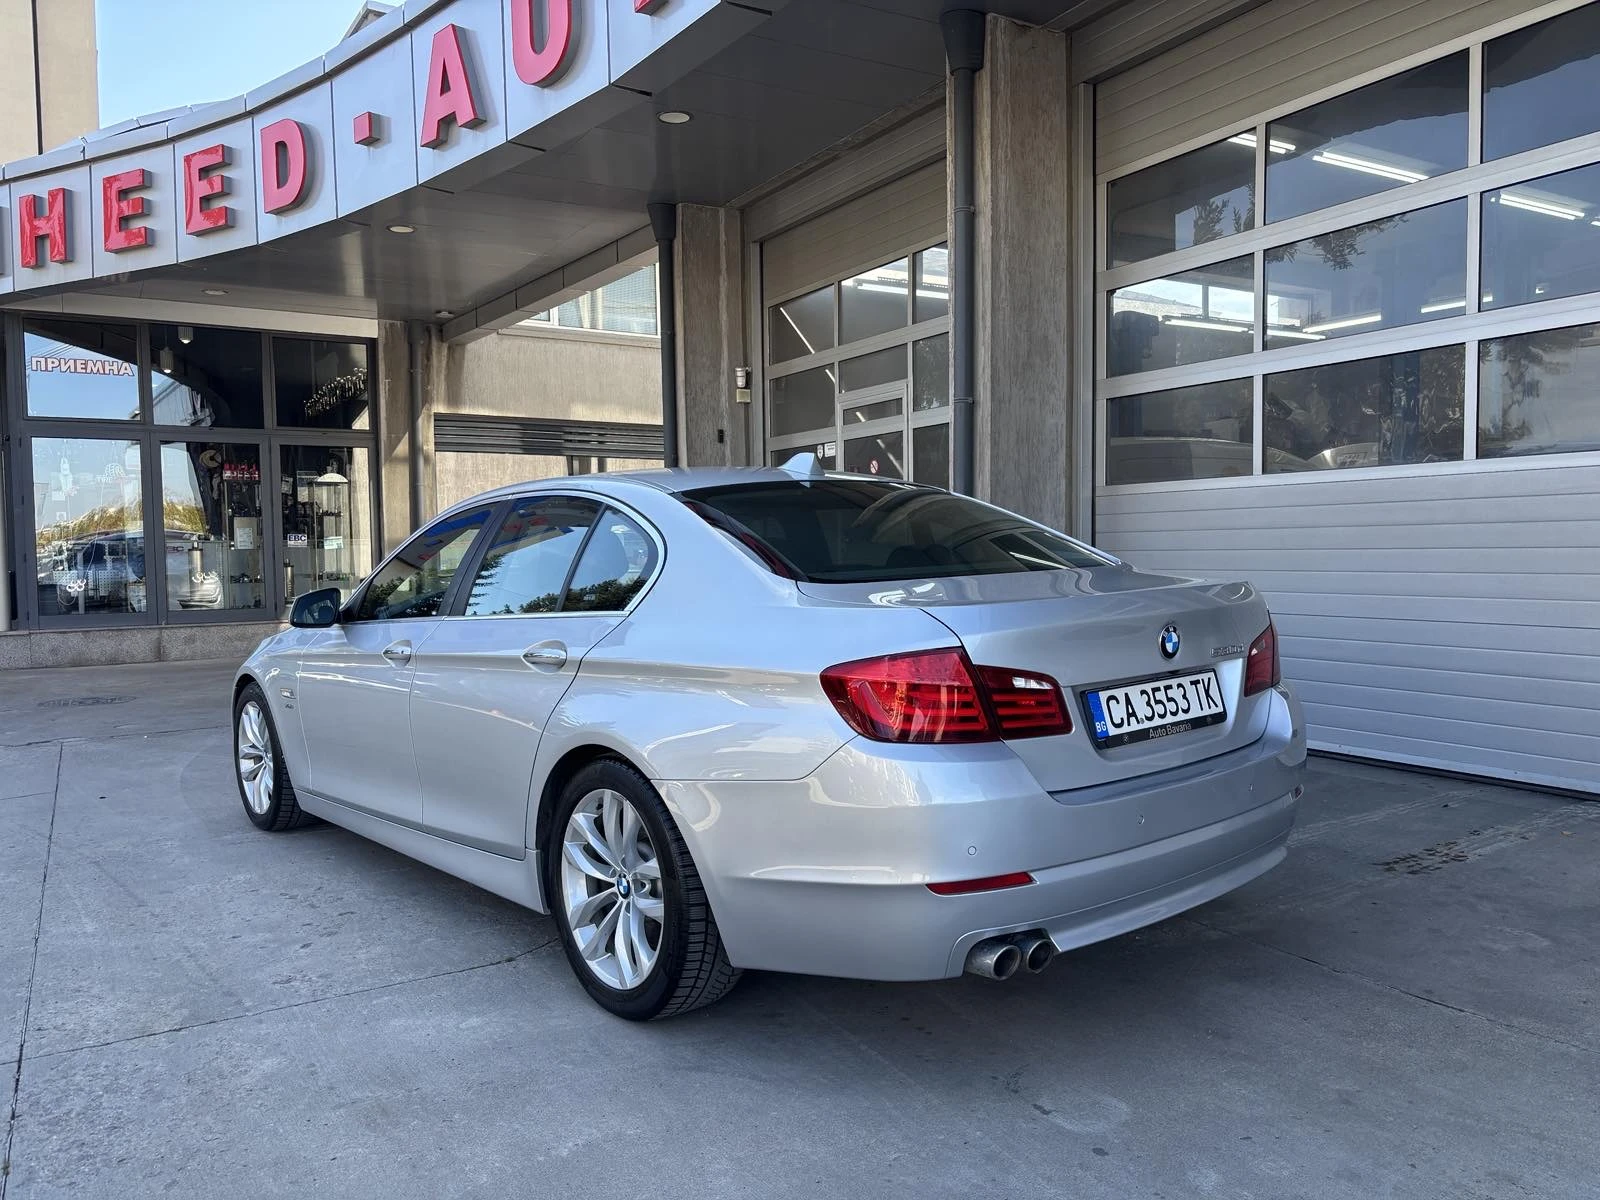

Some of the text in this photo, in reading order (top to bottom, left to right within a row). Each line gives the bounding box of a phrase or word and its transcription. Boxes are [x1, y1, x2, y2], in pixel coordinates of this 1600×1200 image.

[0, 117, 312, 276] HEED
[421, 0, 662, 148] AU
[31, 356, 135, 376] ПРИЕМНА
[288, 534, 307, 542] EBC
[1096, 721, 1107, 733] BG
[1149, 721, 1192, 739] Auto Bavaria
